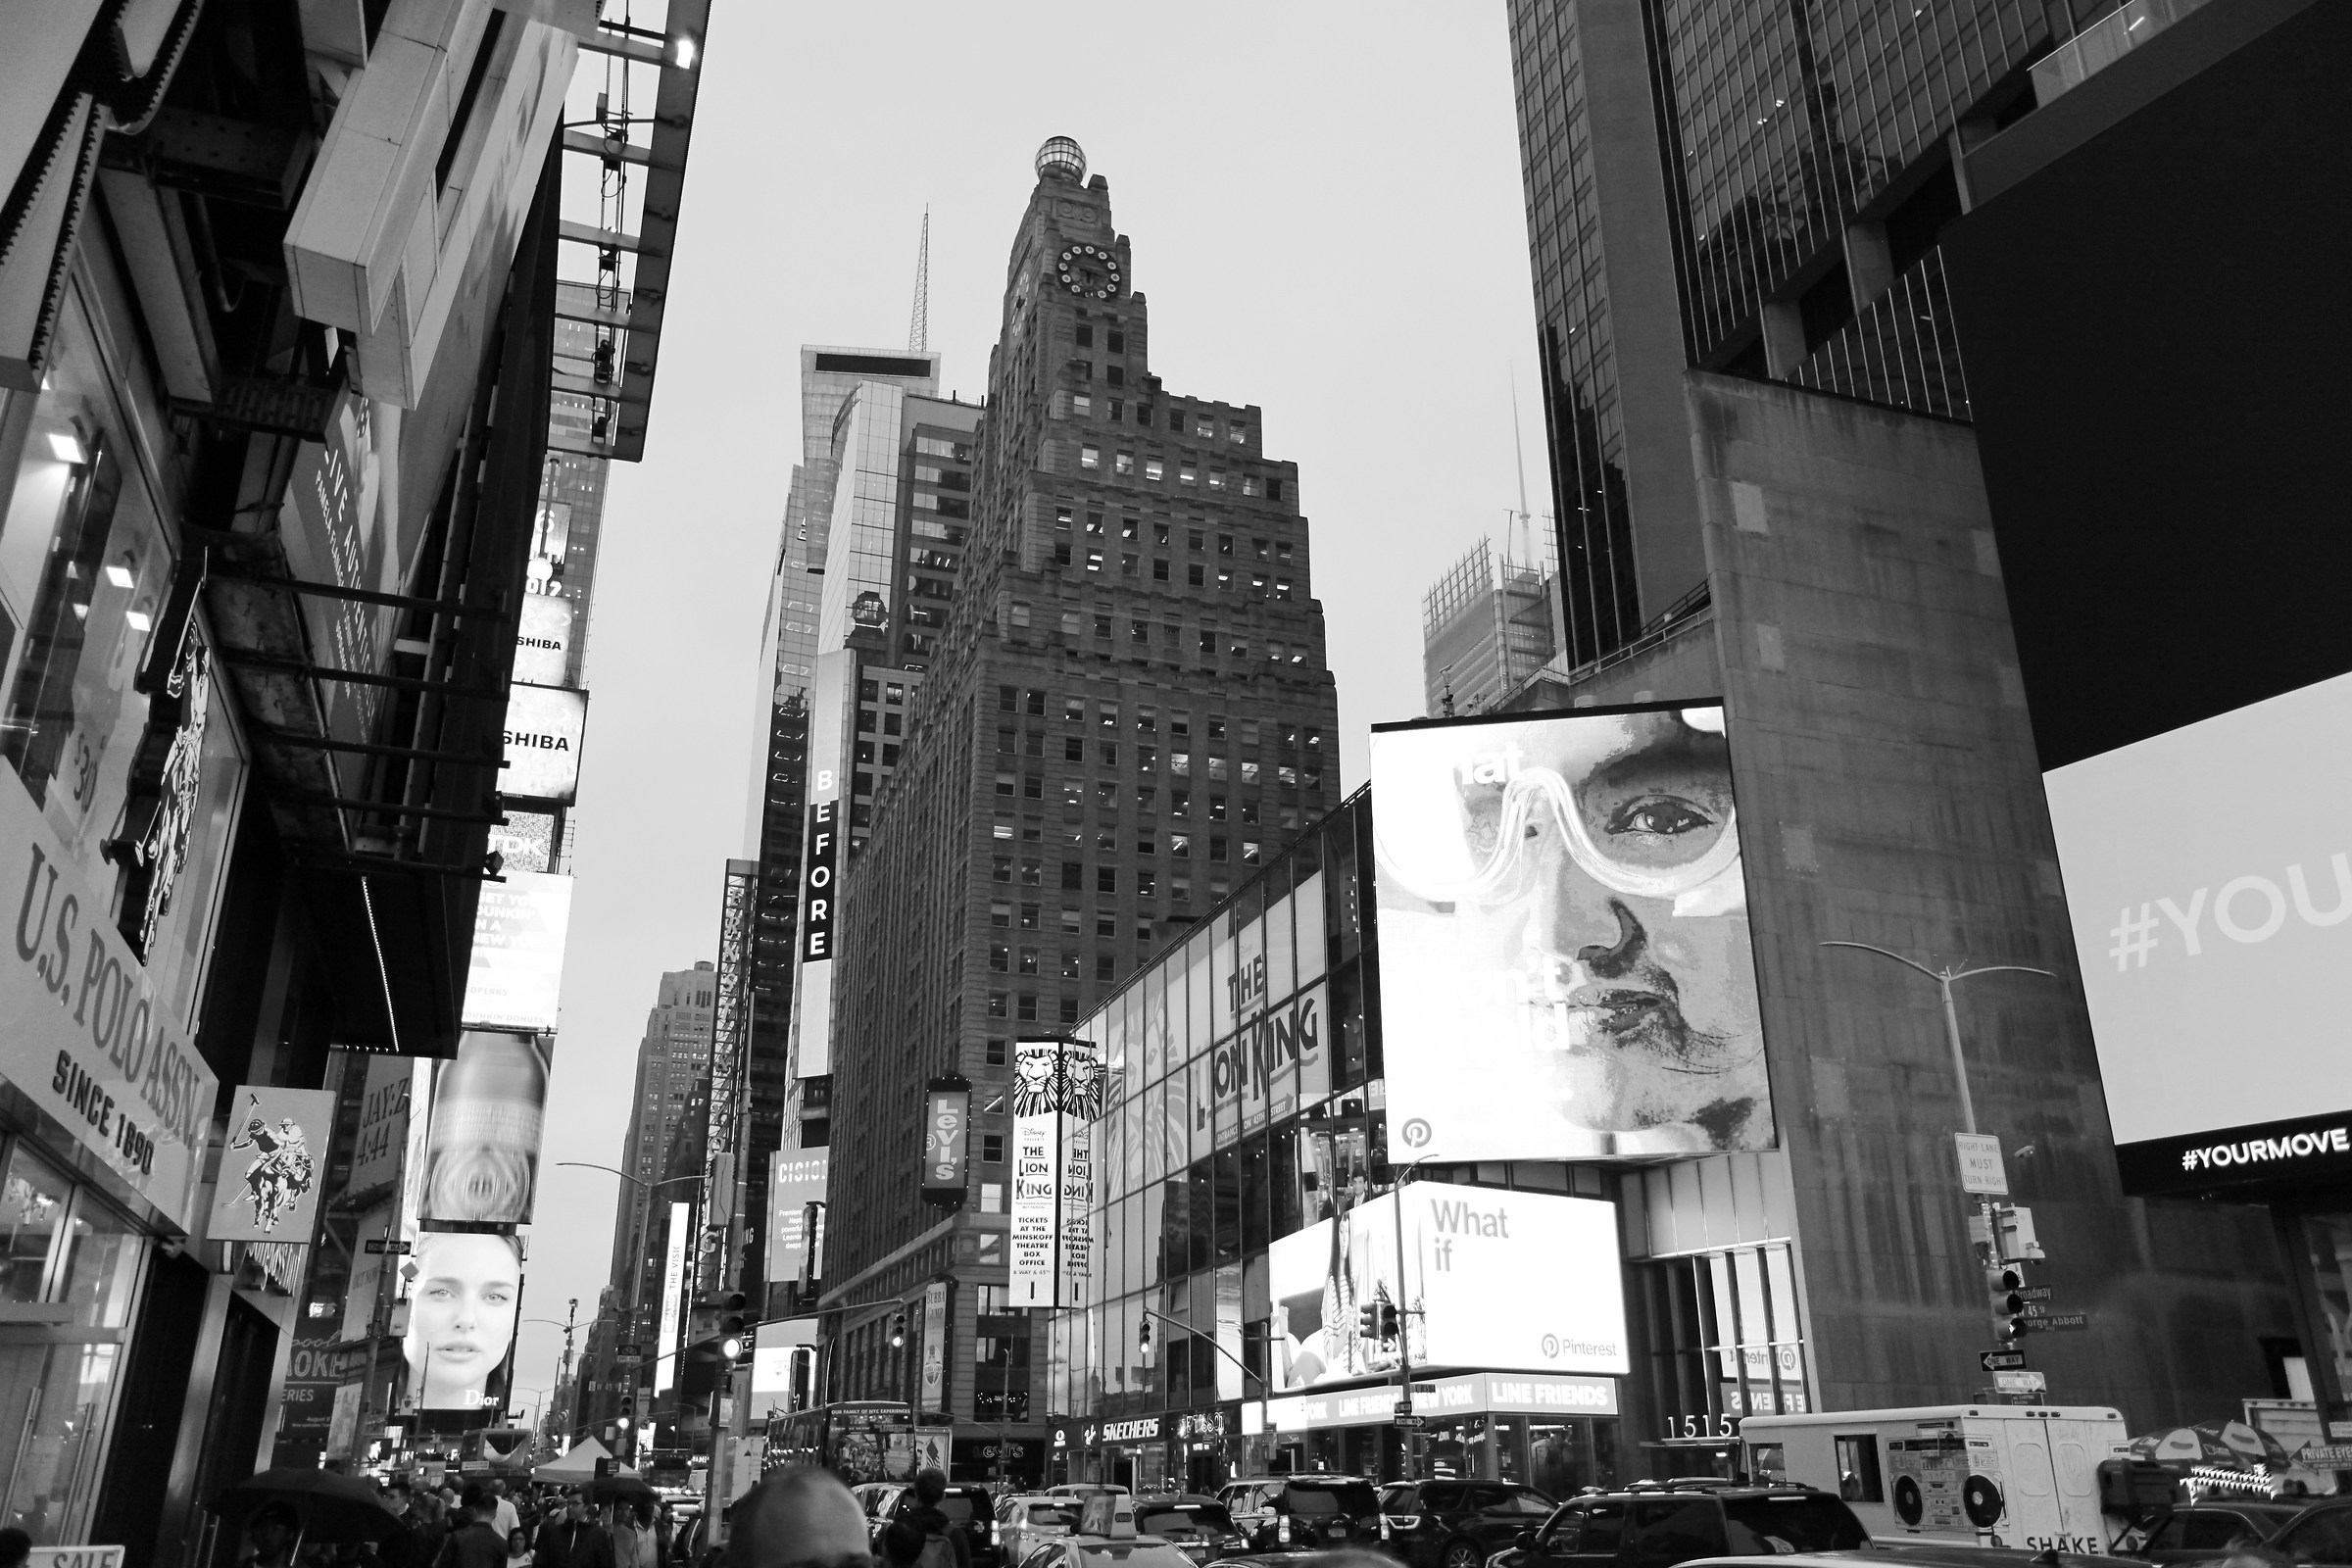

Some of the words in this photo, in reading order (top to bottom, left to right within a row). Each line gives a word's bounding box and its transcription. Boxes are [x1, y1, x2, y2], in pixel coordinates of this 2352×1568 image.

[524, 580, 563, 597] 017
[516, 636, 562, 651] SHIBA
[503, 730, 569, 752] SHIBA
[809, 769, 833, 956] BEFORE
[1227, 954, 1264, 1013] THE
[73, 927, 149, 1083] POLO
[52, 1049, 116, 1138] SINCE
[116, 1113, 155, 1175] 1890
[1243, 1119, 1252, 1130] ON
[1270, 1100, 1287, 1117] STREET
[357, 1121, 392, 1166] 4:44
[1022, 1146, 1045, 1156] THE
[1982, 1144, 2000, 1153] LANE
[2181, 1128, 2351, 1171] #YOURMOVE
[779, 1159, 826, 1184] CISIO
[1018, 1158, 1049, 1177] LION
[1970, 1157, 1993, 1170] MUST
[1015, 1178, 1053, 1200] KING
[1964, 1175, 1983, 1185] TURN
[1984, 1176, 2005, 1187] RIGHT
[1430, 1199, 1509, 1239] What
[1434, 1238, 1452, 1272] if
[669, 1271, 678, 1290] THE
[927, 1291, 946, 1304] BUBBA
[2028, 1305, 2037, 1316] 45
[2052, 1316, 2083, 1326] Abbott
[1562, 1339, 1617, 1357] Pinterest
[1986, 1357, 2000, 1366] ONE
[2006, 1355, 2022, 1365] WAY
[2001, 1378, 2016, 1387] ONE
[464, 1389, 500, 1407] Dior
[1441, 1384, 1474, 1407] YORK
[1492, 1382, 1532, 1403] LINE
[1535, 1385, 1608, 1405] FRIENDS
[1339, 1398, 1359, 1417] LINE
[1102, 1417, 1159, 1442] SKECHERS
[1667, 1413, 1732, 1439] 1515
[2026, 1536, 2099, 1555] SHAKE
